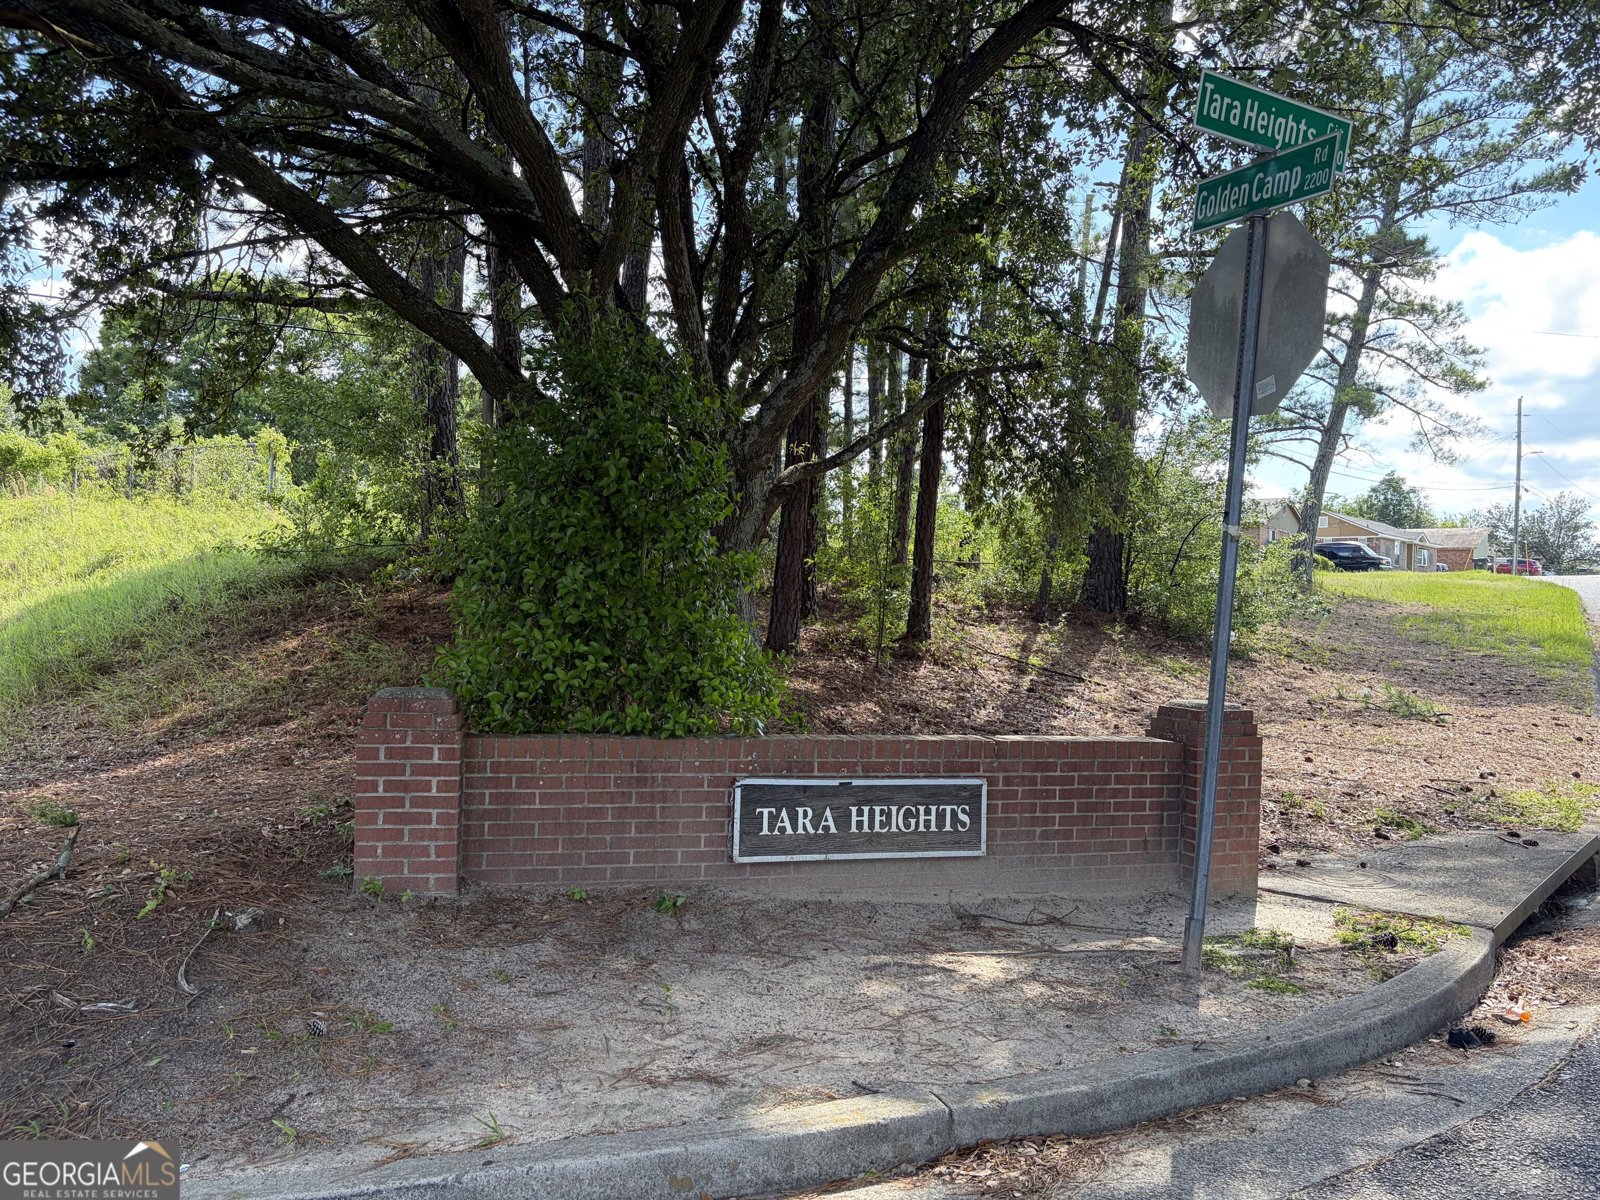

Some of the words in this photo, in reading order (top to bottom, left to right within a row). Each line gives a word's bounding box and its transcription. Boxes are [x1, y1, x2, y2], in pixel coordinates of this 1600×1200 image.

[1203, 82, 1241, 125] Tara
[1313, 144, 1329, 165] Rd
[1197, 182, 1250, 220] Golden
[1251, 165, 1302, 199] Camp
[1303, 168, 1330, 191] 2200
[755, 806, 838, 836] TARA
[849, 804, 971, 833] HEIGHTS
